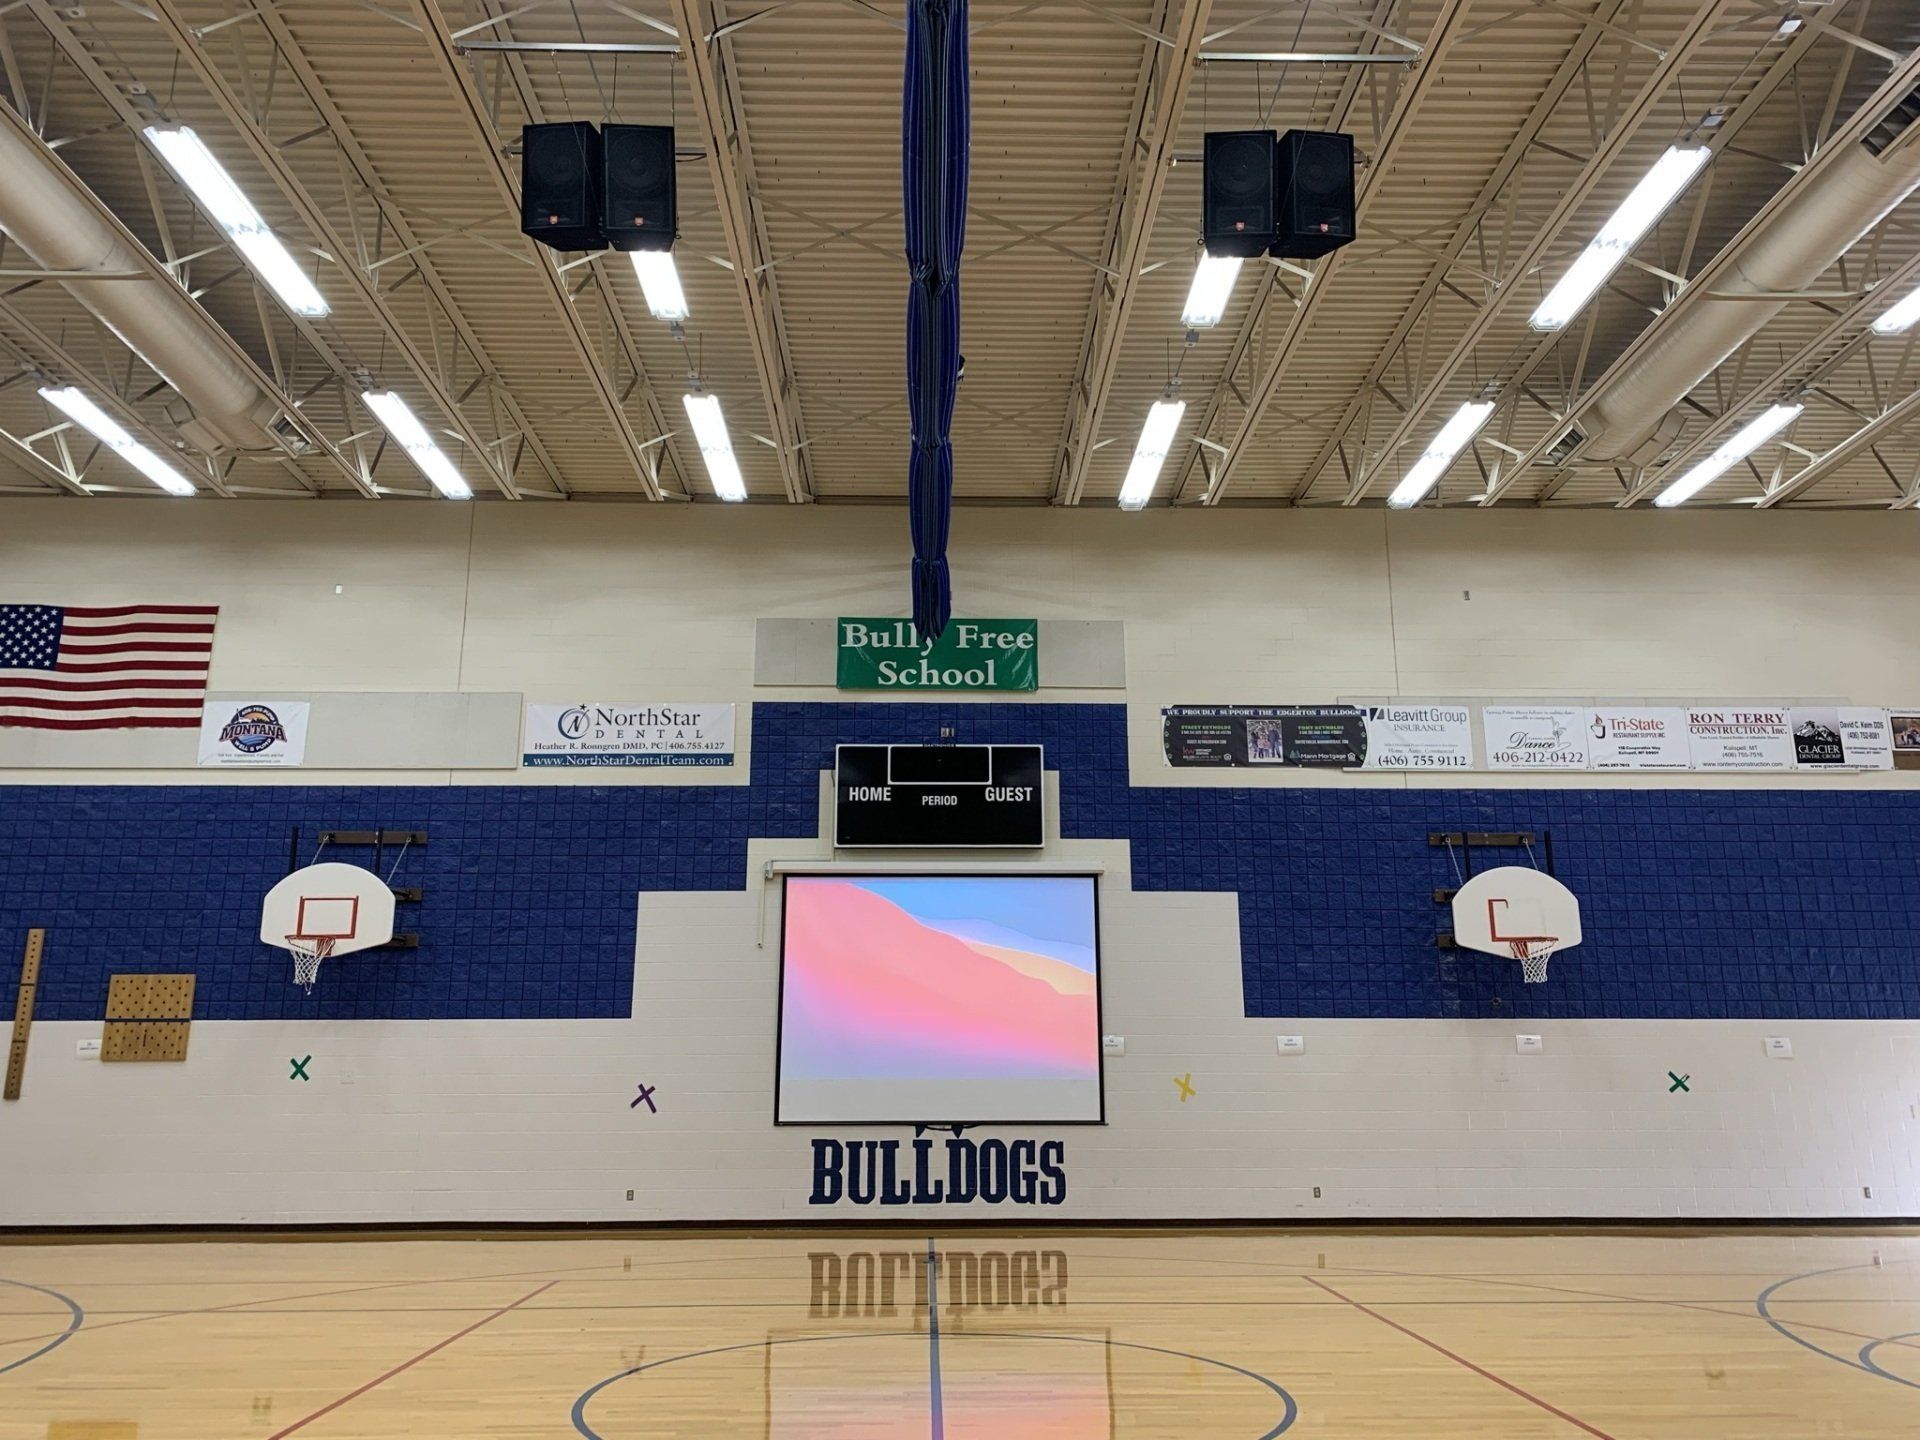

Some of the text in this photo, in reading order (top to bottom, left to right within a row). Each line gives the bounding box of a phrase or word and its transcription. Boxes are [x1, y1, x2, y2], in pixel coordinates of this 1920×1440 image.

[956, 625, 1034, 649] Free
[878, 659, 997, 686] School
[595, 708, 701, 726] NorthStar
[1387, 708, 1467, 725] Leavitt Group
[1690, 713, 1784, 724] RON TERRY
[1394, 724, 1446, 732] INSURANCE
[1608, 717, 1664, 731] Tri-State
[1772, 726, 1787, 734] Inc.
[220, 724, 286, 741] MONTANA
[596, 729, 703, 739] DENTAL
[534, 742, 566, 750] Heather
[622, 743, 648, 751] DMD,
[1506, 732, 1556, 749] Dance
[1799, 745, 1840, 753] GLACIER
[533, 755, 724, 765] www.NorthStarDentalTeam.com
[1378, 755, 1467, 766] (406) 755 9112
[1493, 752, 1583, 763] 406-212-0422
[849, 787, 892, 802] HOME
[922, 795, 957, 806] PERIOD
[985, 787, 1033, 802] GUEST
[809, 1139, 1066, 1205] BULLDOGS
